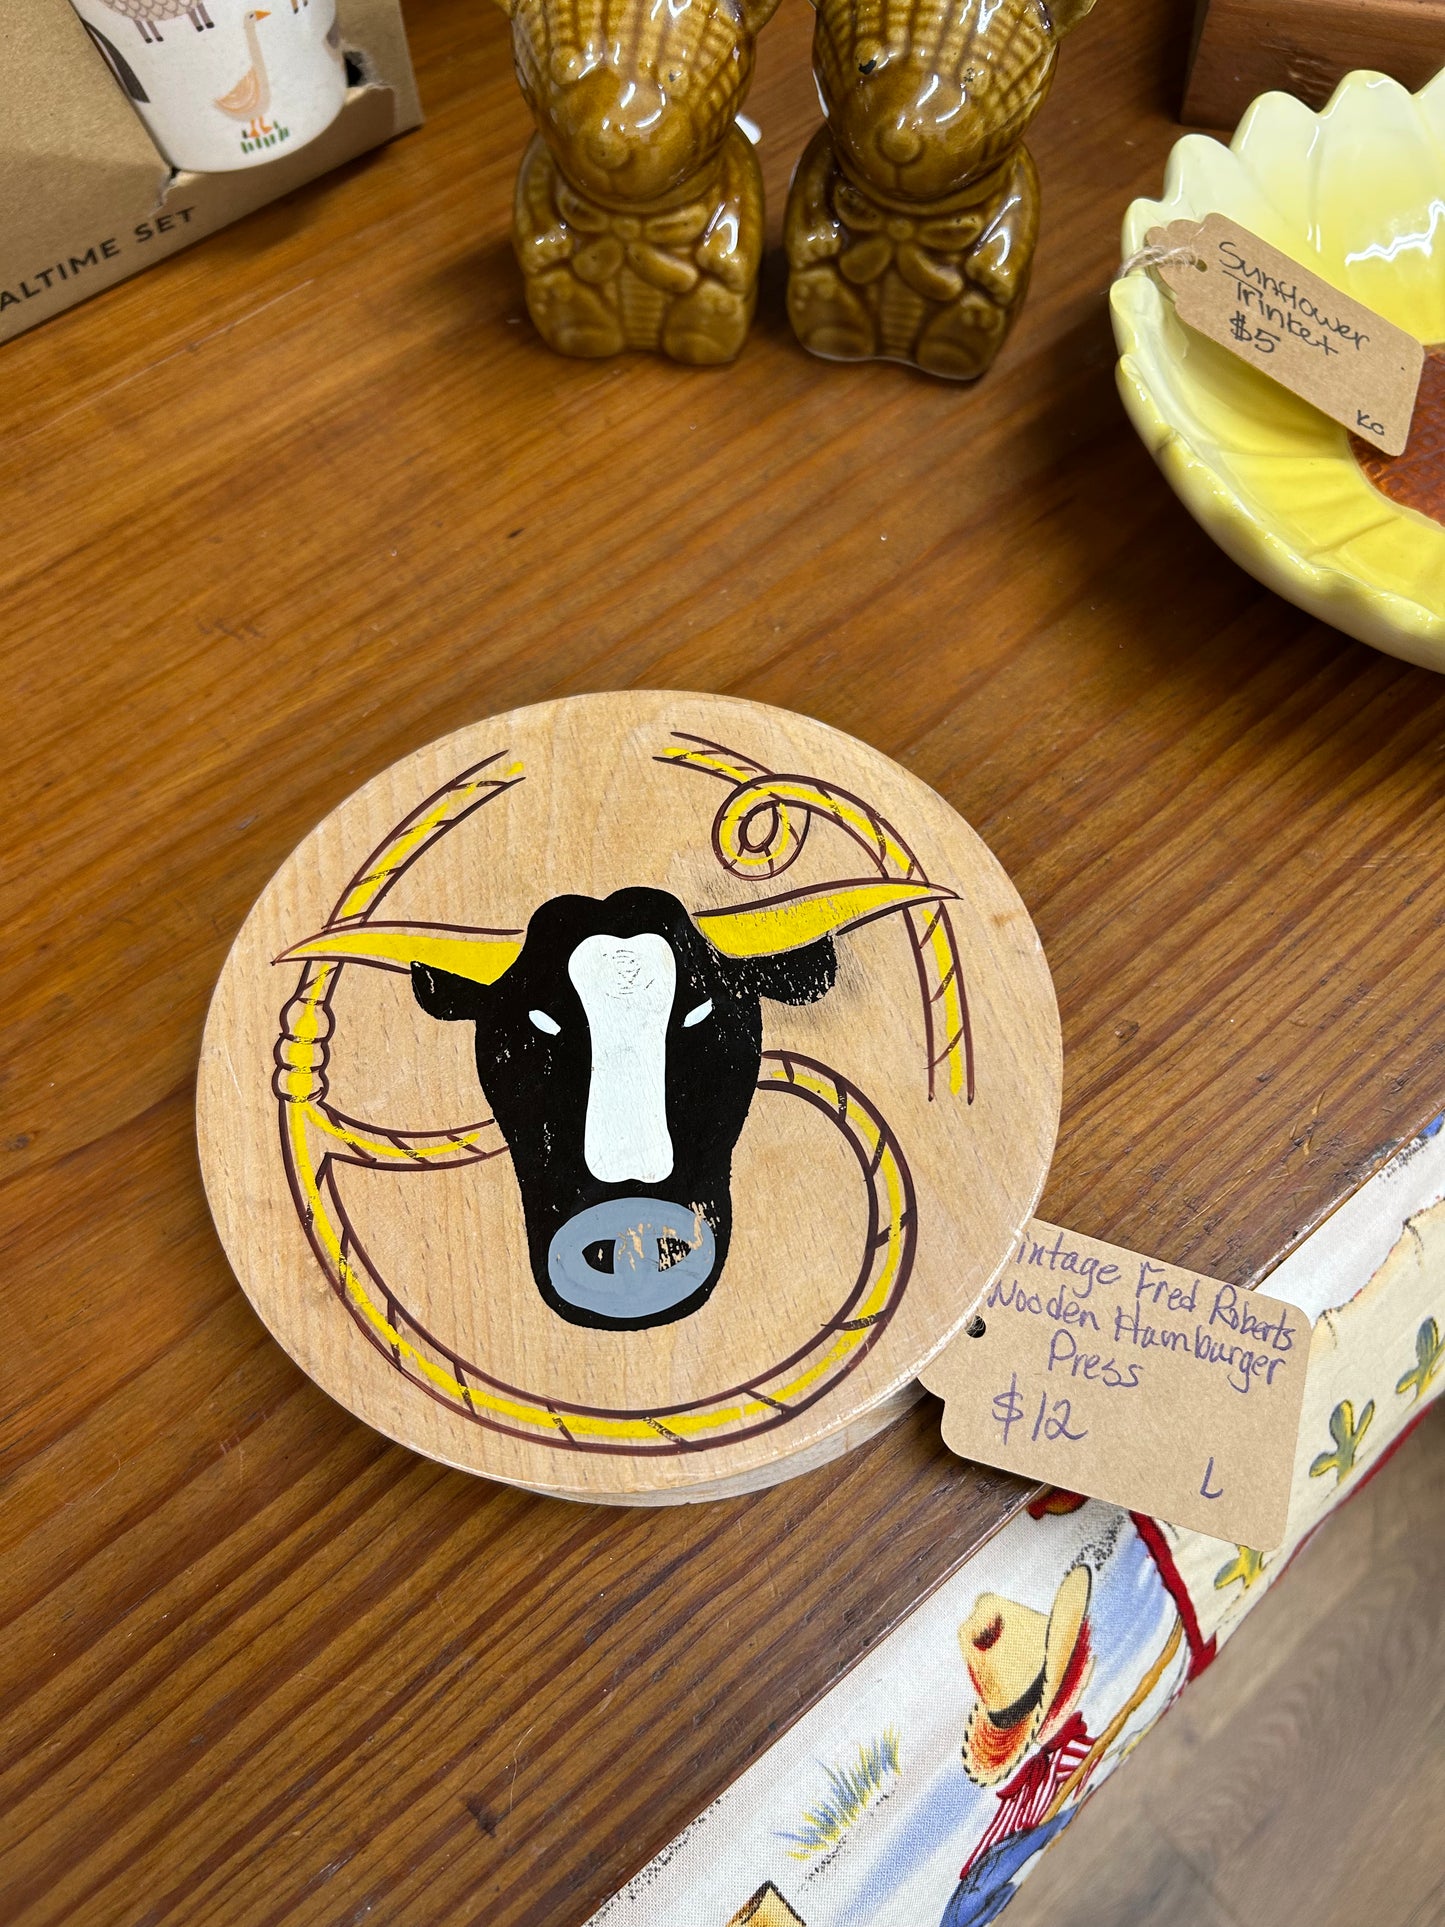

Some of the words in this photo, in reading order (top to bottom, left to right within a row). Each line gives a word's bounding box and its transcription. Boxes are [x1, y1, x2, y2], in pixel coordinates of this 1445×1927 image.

[0, 238, 121, 312] ALTIME
[134, 206, 196, 243] SET
[1218, 241, 1370, 350] Sunflower
[1229, 310, 1281, 353] $5
[1016, 1231, 1121, 1298] intage
[1135, 1261, 1201, 1313] Fred
[1208, 1284, 1296, 1351] Roberts
[1048, 1329, 1143, 1387] Press
[1114, 1301, 1286, 1394] Hamburger
[991, 1371, 1089, 1446] $12
